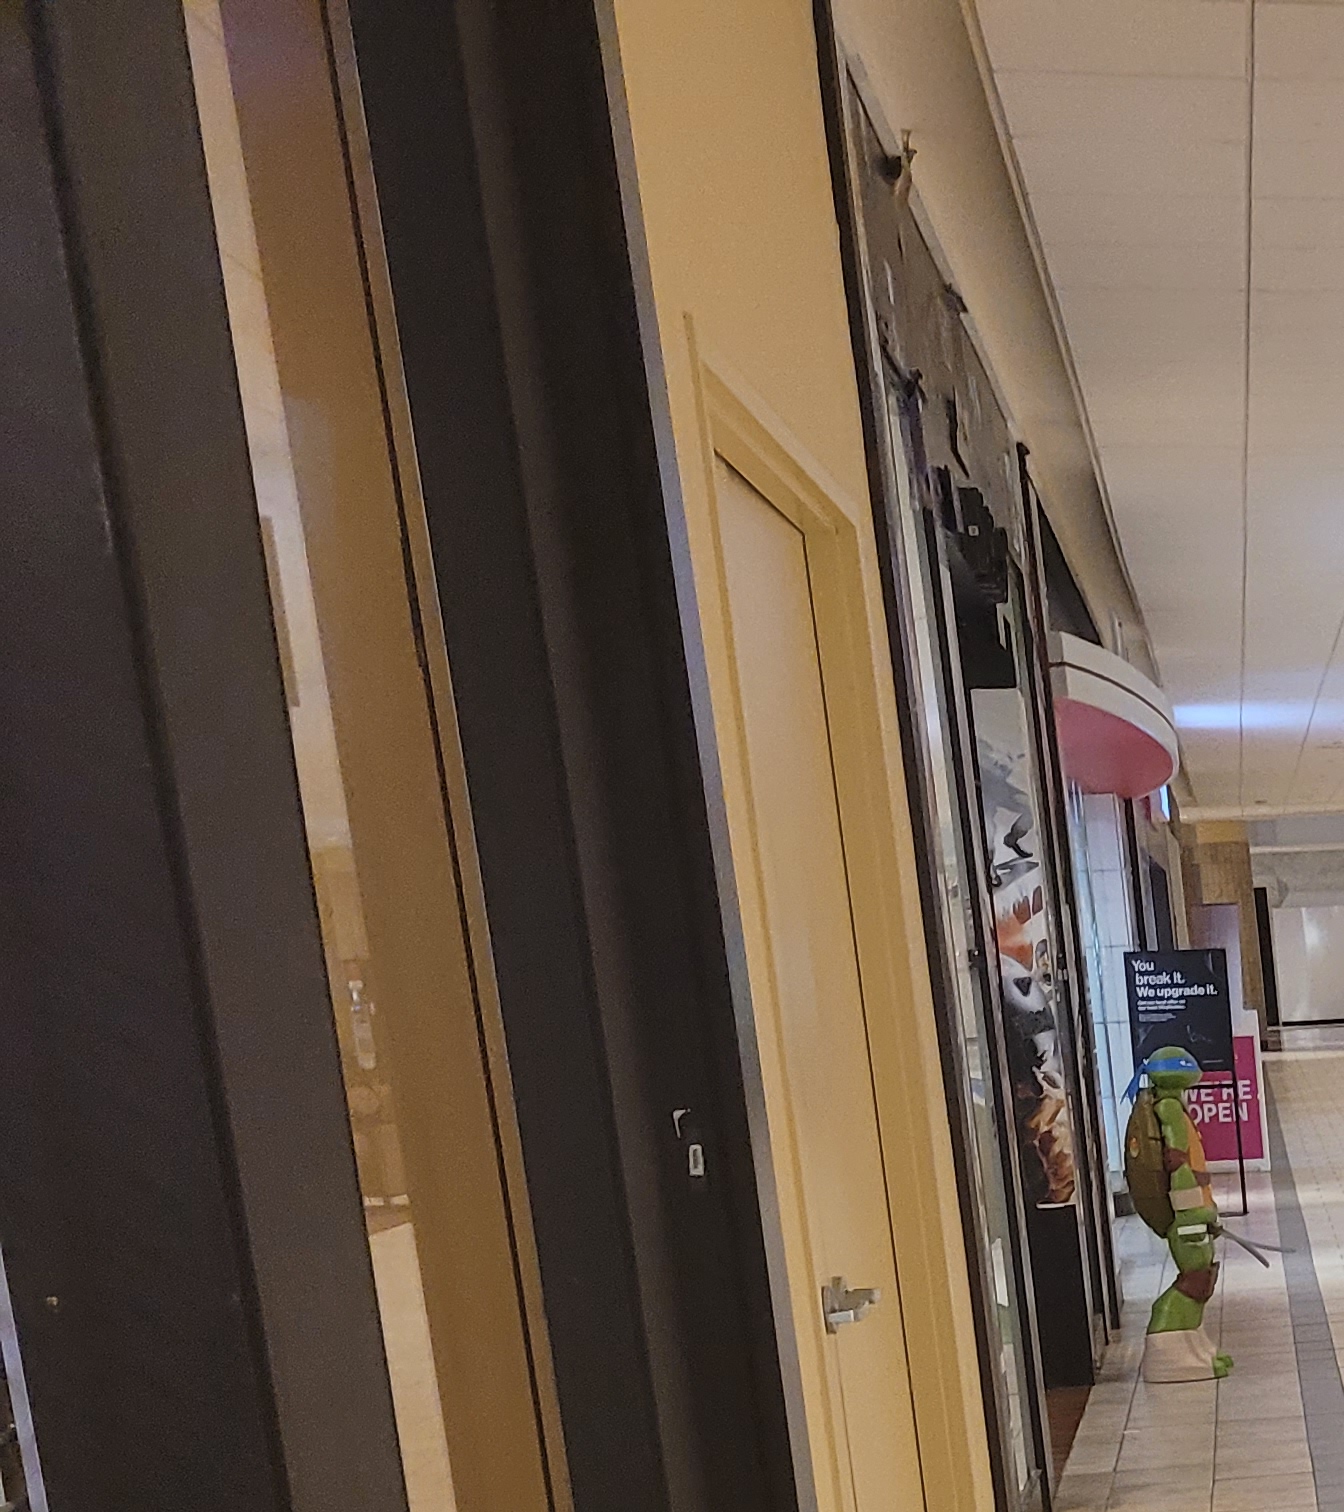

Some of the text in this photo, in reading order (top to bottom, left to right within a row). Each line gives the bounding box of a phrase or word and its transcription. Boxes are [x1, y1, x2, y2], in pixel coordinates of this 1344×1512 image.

[1132, 959, 1155, 972] You
[1136, 971, 1186, 986] break it.
[1136, 984, 1218, 999] We upgrade it.
[1181, 1080, 1252, 1101] WE'RE
[1188, 1102, 1249, 1123] OPEN
